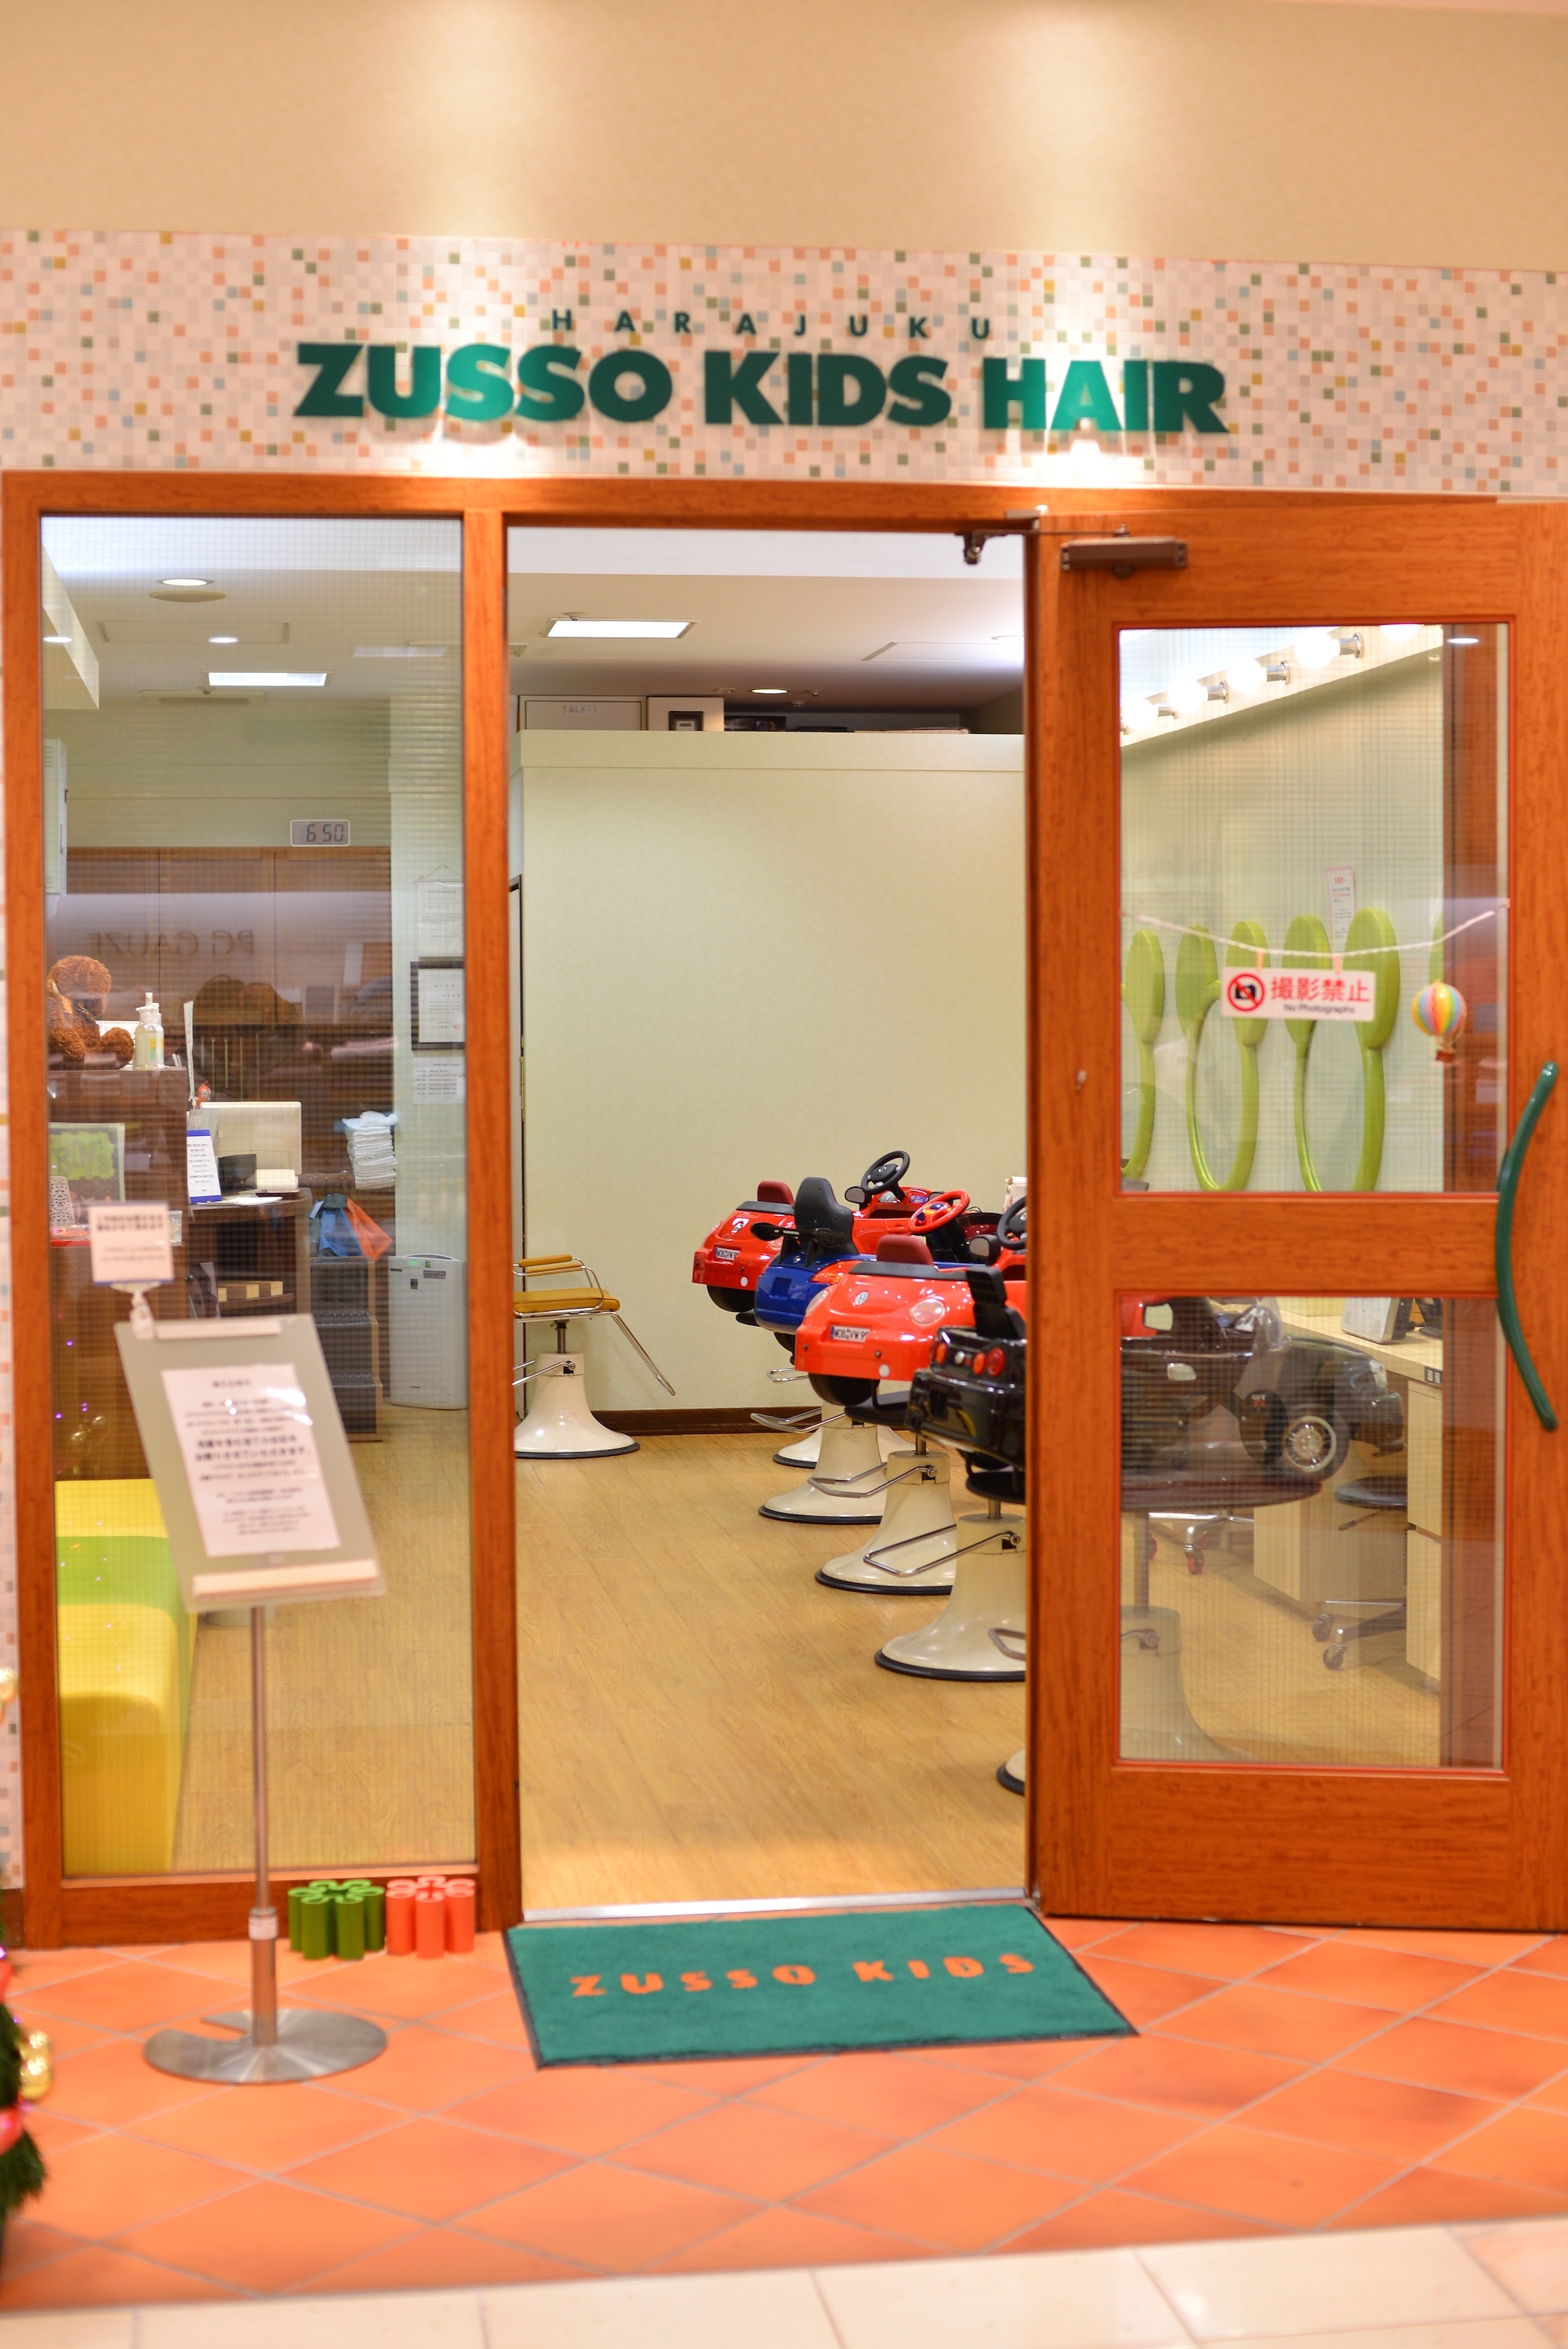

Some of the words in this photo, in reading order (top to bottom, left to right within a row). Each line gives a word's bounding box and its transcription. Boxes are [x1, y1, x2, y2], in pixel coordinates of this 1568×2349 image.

[552, 309, 990, 339] HARAJUKU
[293, 342, 673, 423] ZUSSO
[704, 350, 952, 427] KIDS
[983, 356, 1231, 433] HAIR
[1271, 976, 1371, 1003] 撮影禁止
[569, 1964, 816, 1998] ZUSSO
[852, 1954, 1034, 1983] KIDS
